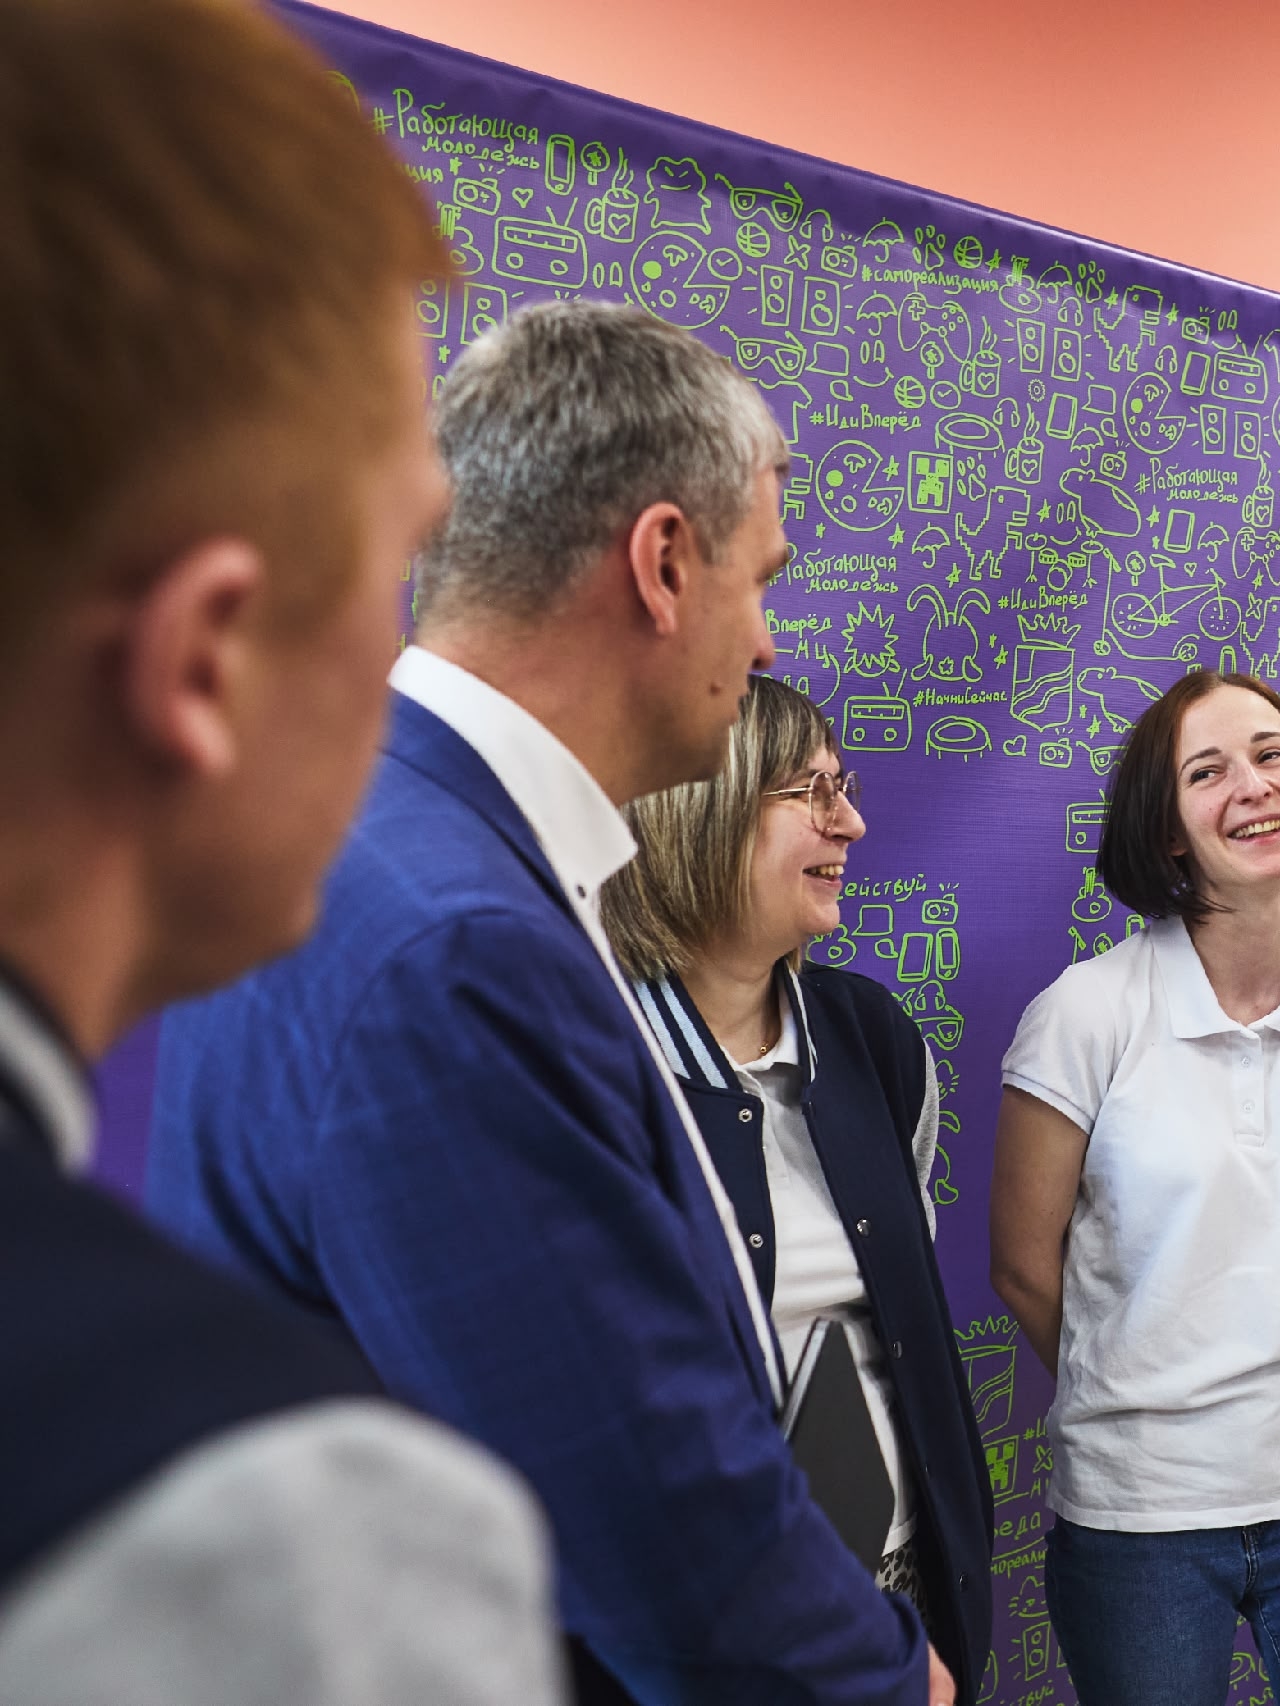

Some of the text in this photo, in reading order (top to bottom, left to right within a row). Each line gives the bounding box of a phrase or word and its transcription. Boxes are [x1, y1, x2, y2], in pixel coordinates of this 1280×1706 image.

[372, 88, 539, 153] #Работающая
[861, 265, 1000, 295] #самореализация
[809, 404, 921, 435] #ИдиВперёд
[1134, 457, 1238, 494] #Работающая
[998, 586, 1088, 611] #ИдиВперёд
[765, 608, 832, 639] Вперёд
[913, 688, 1008, 708] #НачниСейчас
[836, 873, 927, 902] ействуй
